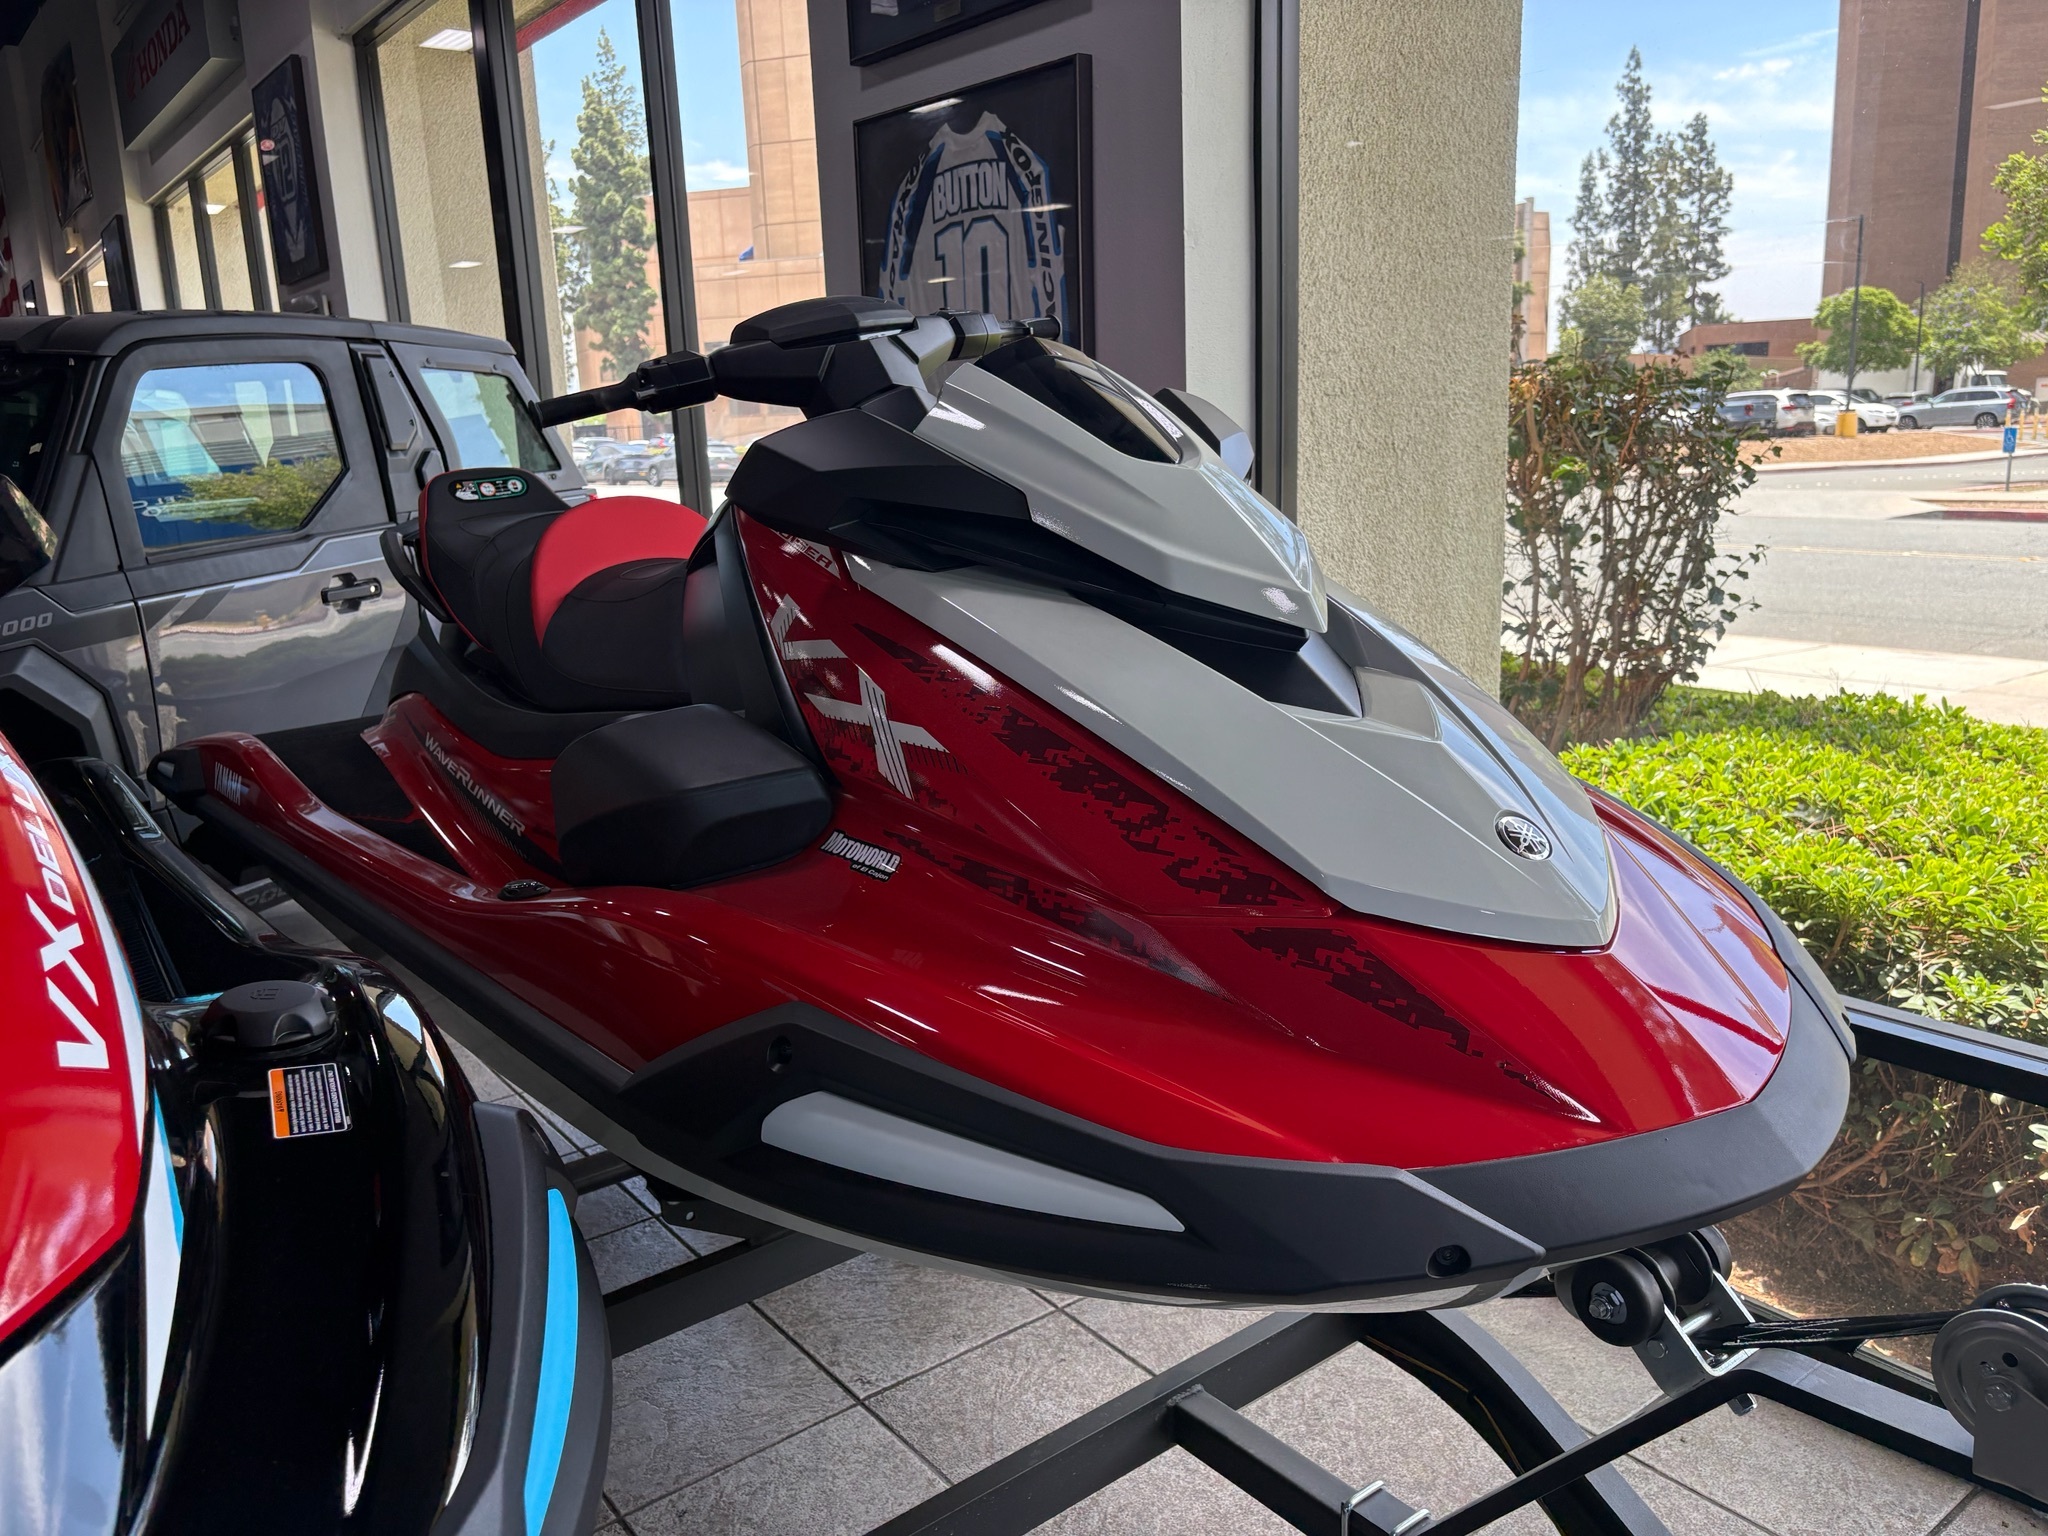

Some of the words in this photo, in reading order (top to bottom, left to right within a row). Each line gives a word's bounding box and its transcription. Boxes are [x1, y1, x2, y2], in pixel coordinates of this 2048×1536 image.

[137, 0, 191, 89] HONDA
[933, 158, 1008, 224] BUTTON
[934, 215, 1011, 320] 10
[0, 612, 53, 637] 000
[214, 761, 242, 807] YAMAHA
[425, 731, 526, 837] WAVERUNNER
[0, 742, 77, 916] DELUX
[868, 869, 889, 881] Cajon
[25, 892, 110, 1069] VX
[275, 1091, 284, 1109] WARNING
